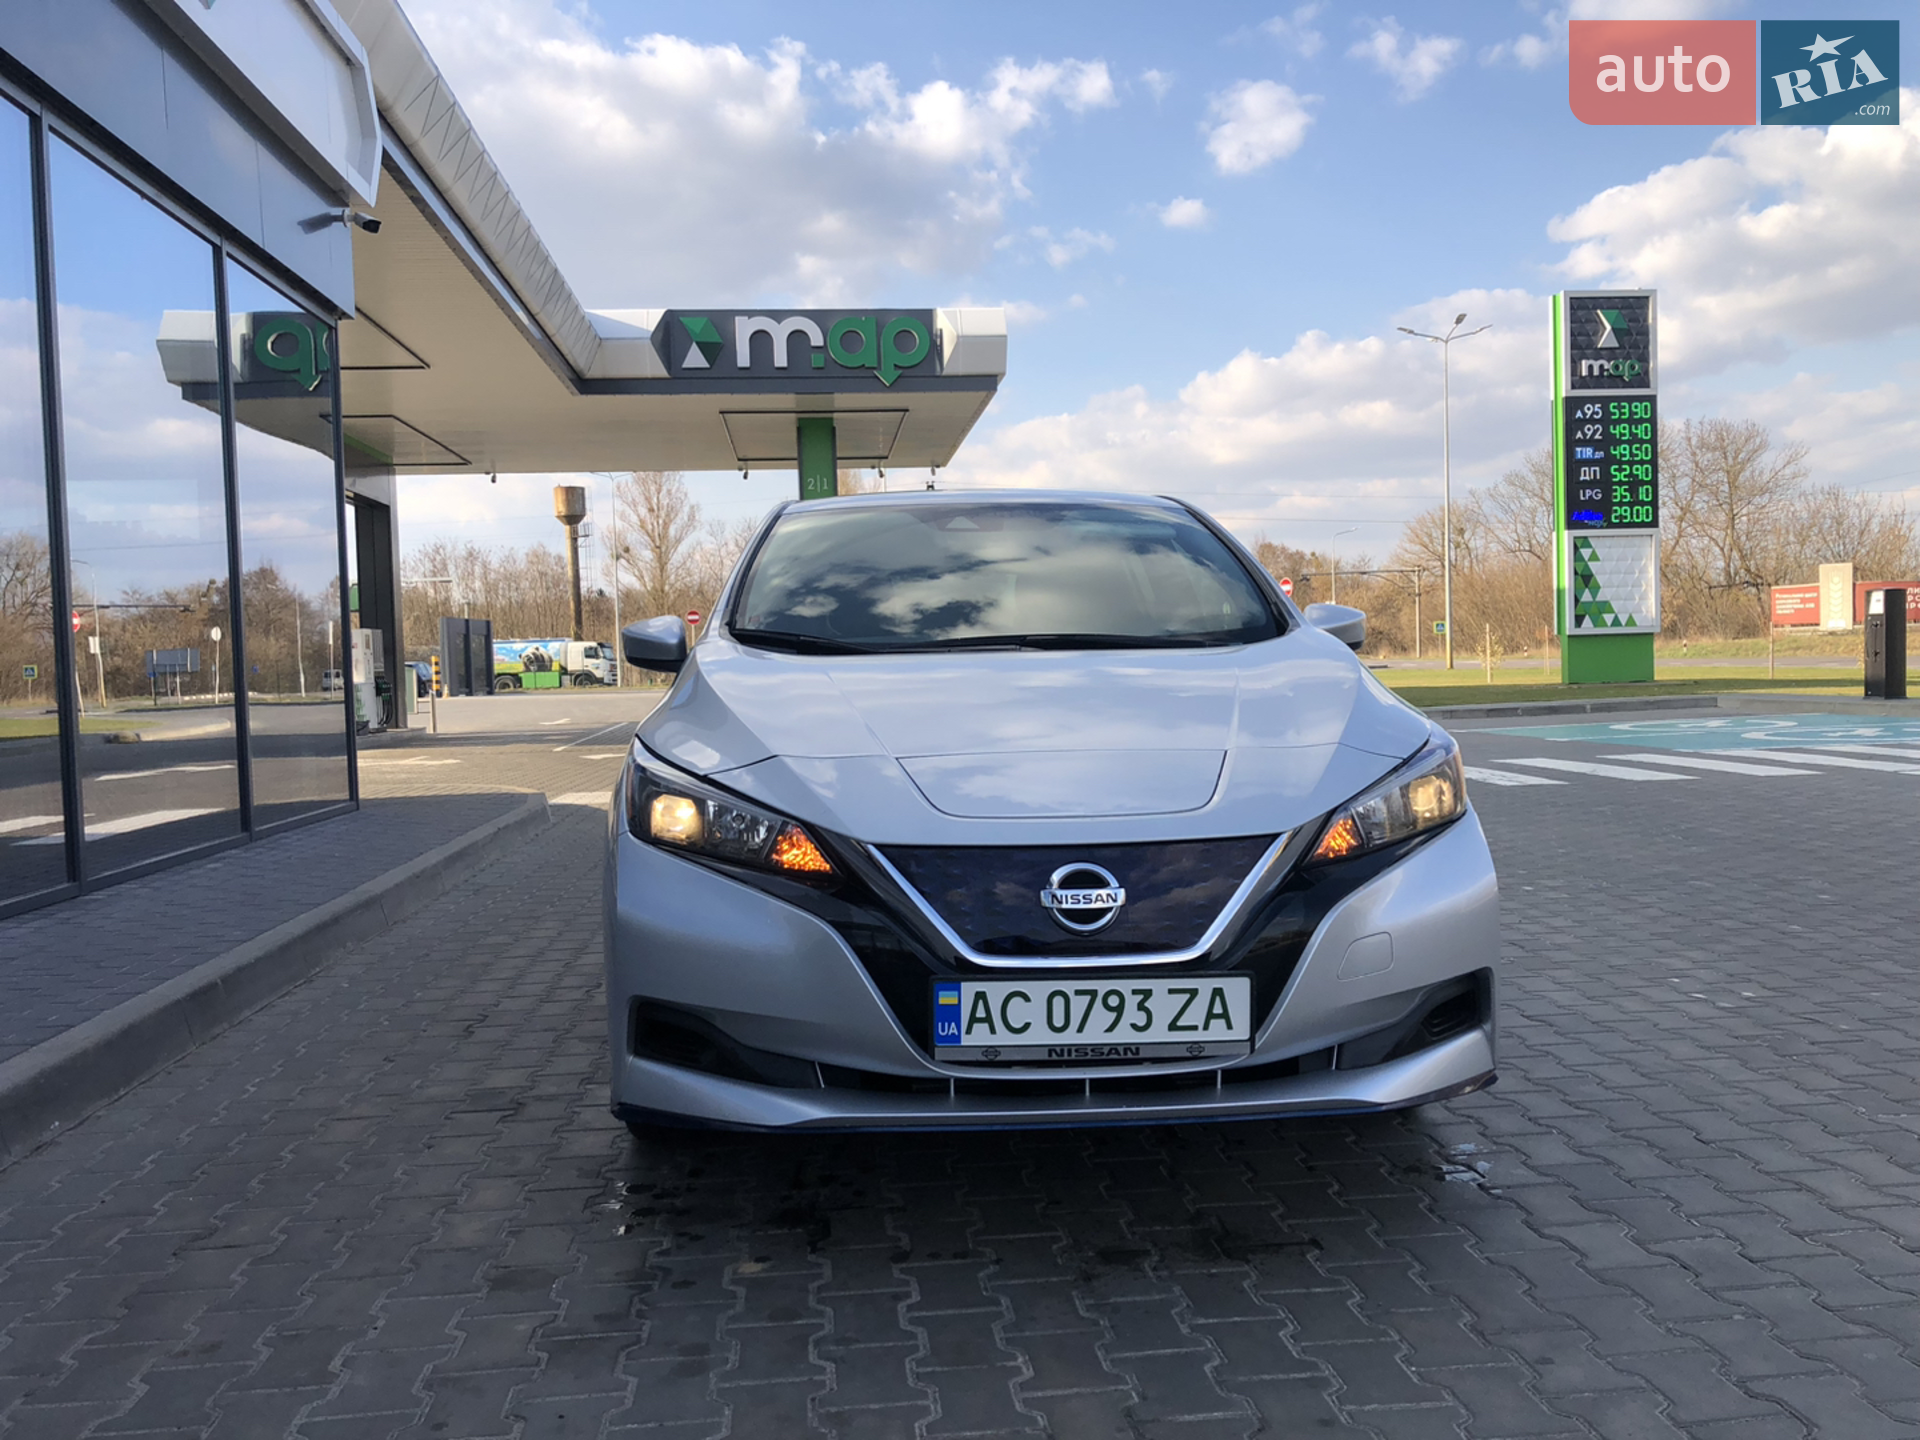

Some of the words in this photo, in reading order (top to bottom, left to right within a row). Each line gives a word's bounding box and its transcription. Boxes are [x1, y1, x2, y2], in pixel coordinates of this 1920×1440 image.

[1609, 423, 1652, 440] 49.40
[1610, 444, 1652, 460] 49.50
[1580, 467, 1600, 480] ДП
[1610, 464, 1652, 481] 52.90
[1580, 489, 1602, 500] LPG
[1611, 506, 1652, 523] 29.00
[1051, 892, 1118, 906] NISSAN
[965, 990, 1032, 1035] AC
[1046, 988, 1153, 1034] 0793
[1167, 987, 1234, 1032] ZA
[938, 1022, 959, 1036] UA
[1047, 1046, 1141, 1059] NISSAN
